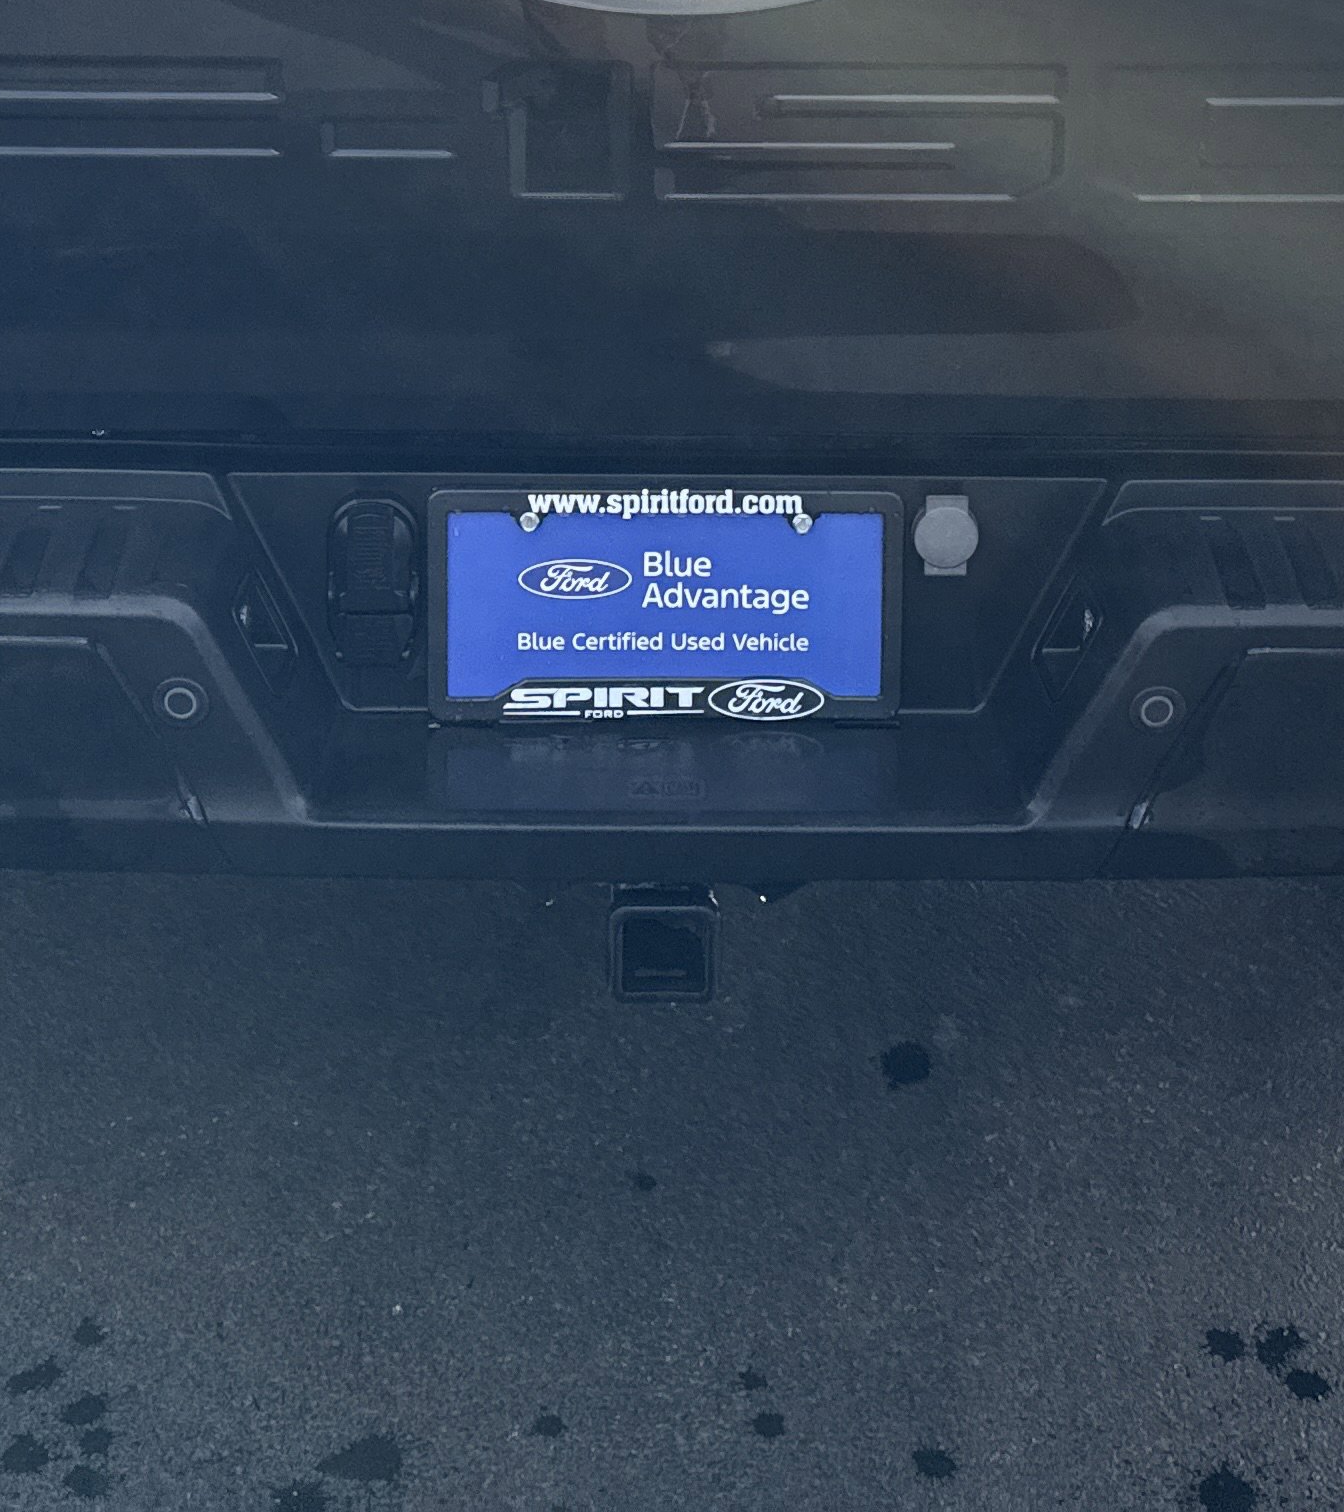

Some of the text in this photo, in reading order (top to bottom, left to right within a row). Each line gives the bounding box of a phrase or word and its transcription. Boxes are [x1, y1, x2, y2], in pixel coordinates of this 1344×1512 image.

[527, 488, 804, 520] www.spiritford.com
[539, 563, 611, 595] Ford
[641, 550, 712, 578] Blue
[641, 581, 810, 615] Advantage
[516, 631, 810, 652] Blue Certified Used Vehicle
[502, 683, 805, 715] SPIRIT Ford
[583, 709, 625, 720] FORD
